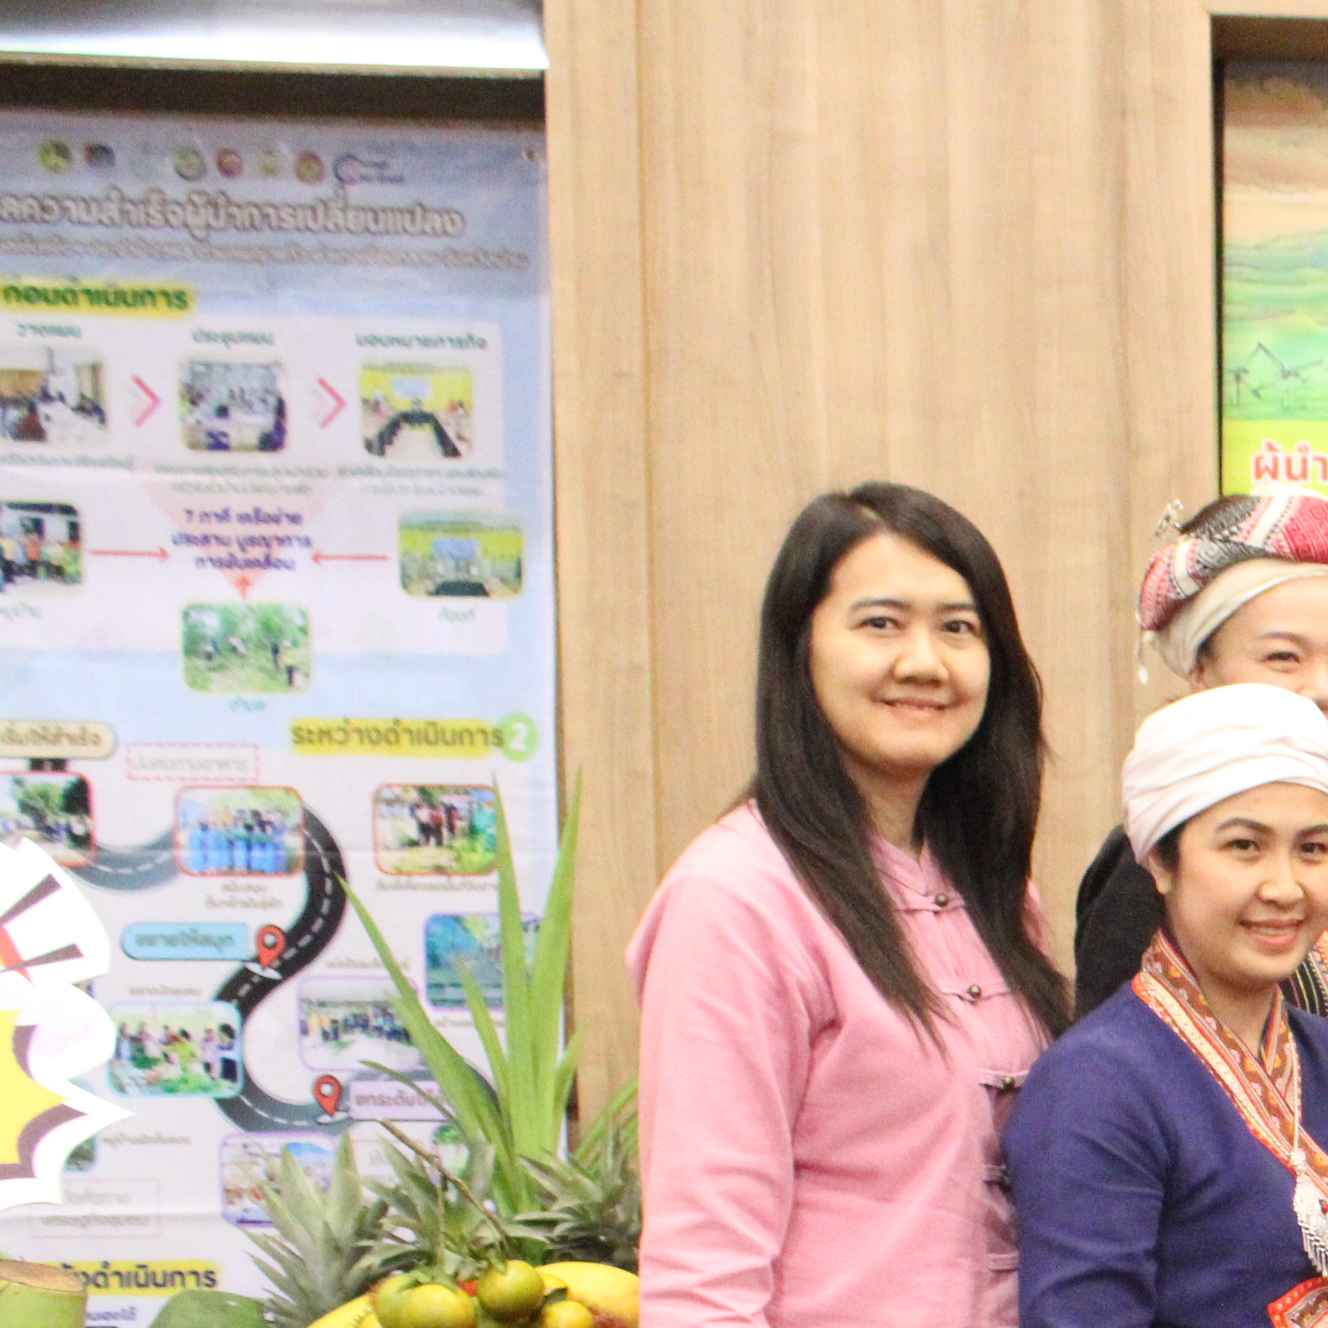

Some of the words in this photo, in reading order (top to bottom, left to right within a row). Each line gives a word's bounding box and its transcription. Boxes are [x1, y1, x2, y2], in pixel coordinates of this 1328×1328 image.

[291, 716, 506, 748] ระหว่างดำเนินการ
[510, 721, 528, 751] 2
